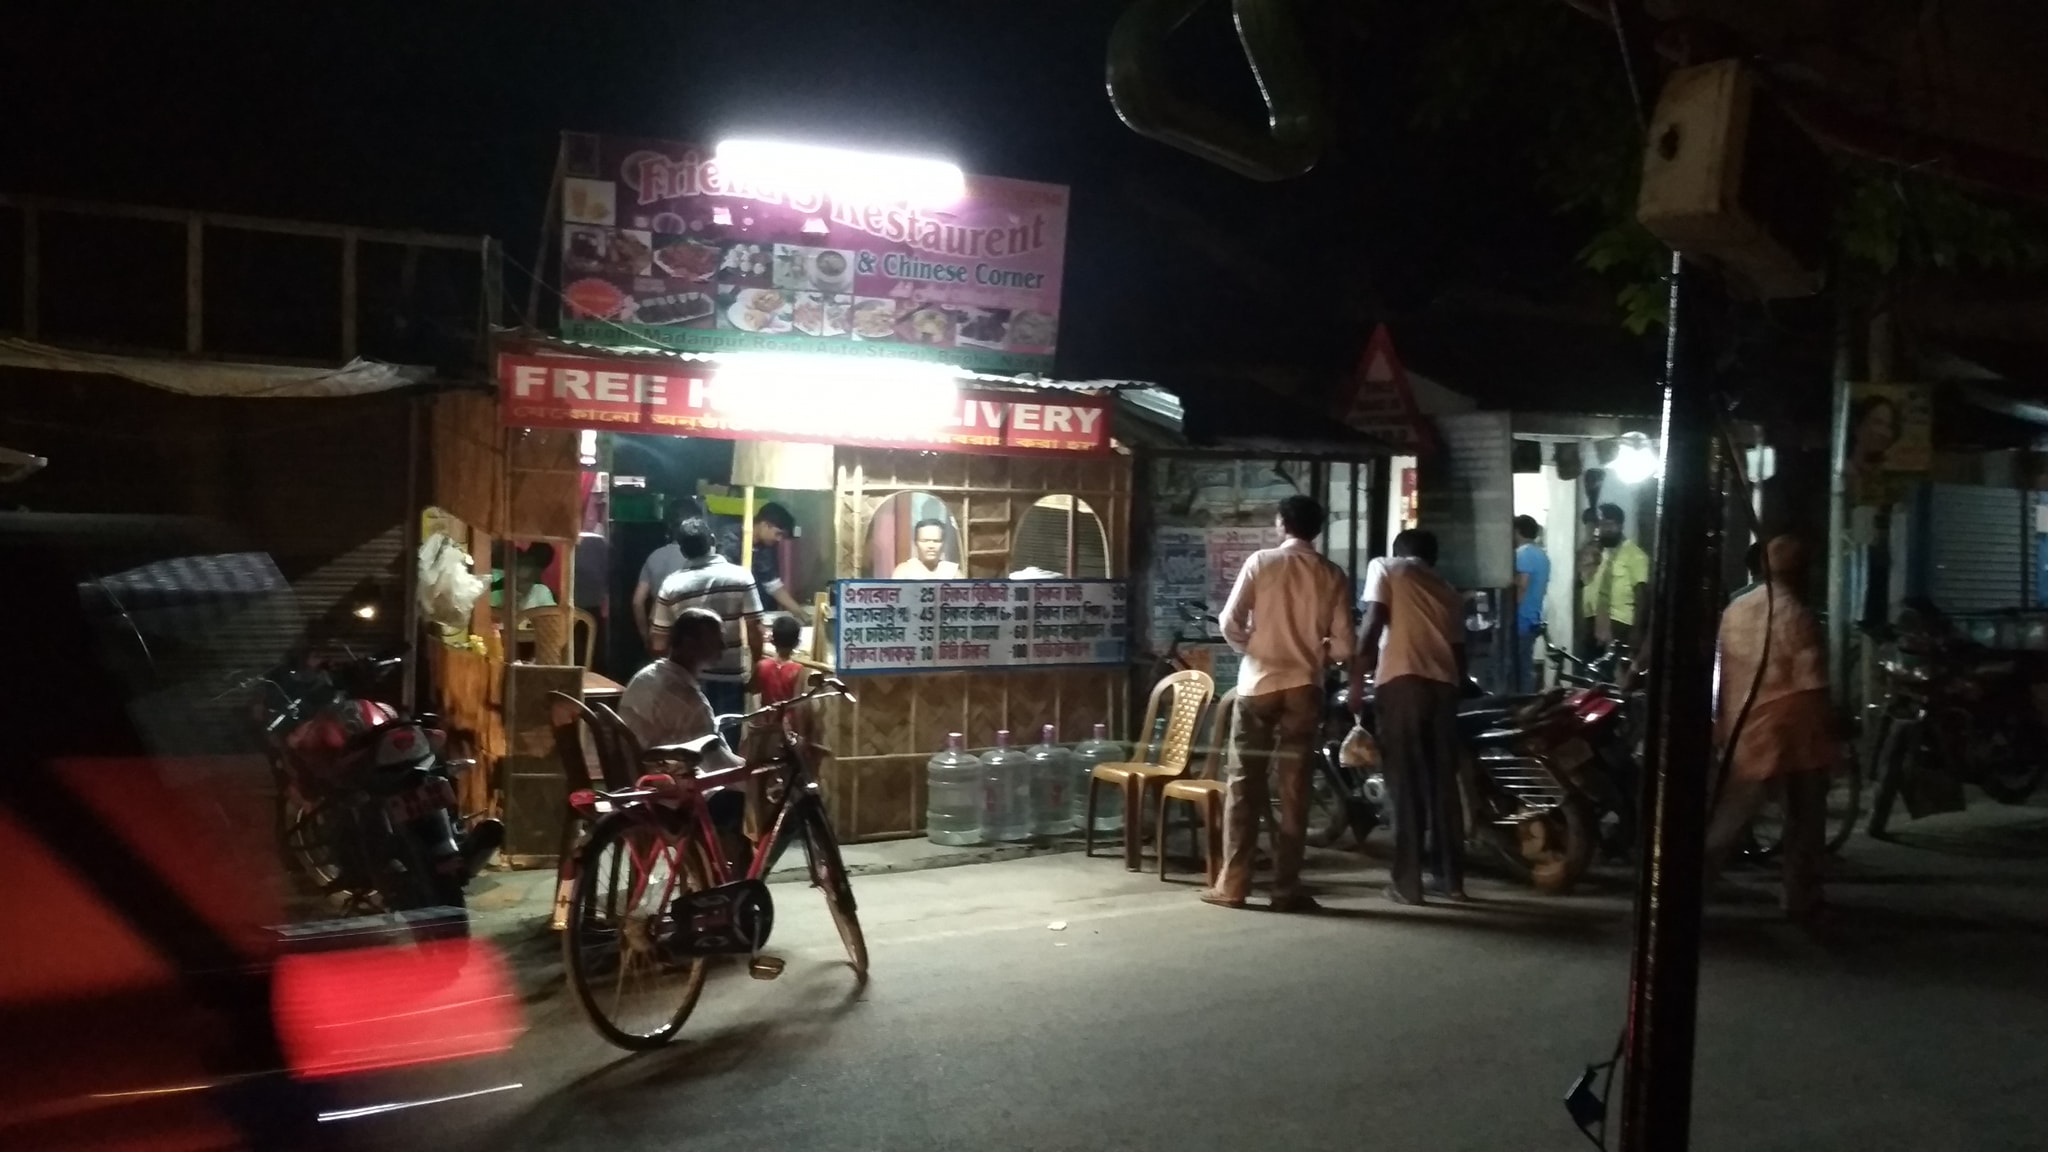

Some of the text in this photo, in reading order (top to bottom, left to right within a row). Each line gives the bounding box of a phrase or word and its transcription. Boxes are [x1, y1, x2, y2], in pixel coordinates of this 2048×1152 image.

[638, 149, 822, 213] Fries
[856, 249, 1045, 289] & Chinese Corner
[643, 328, 745, 348] Madanpur
[752, 336, 802, 350] Road
[514, 365, 668, 405] FREE
[922, 396, 1103, 434] LIVERY
